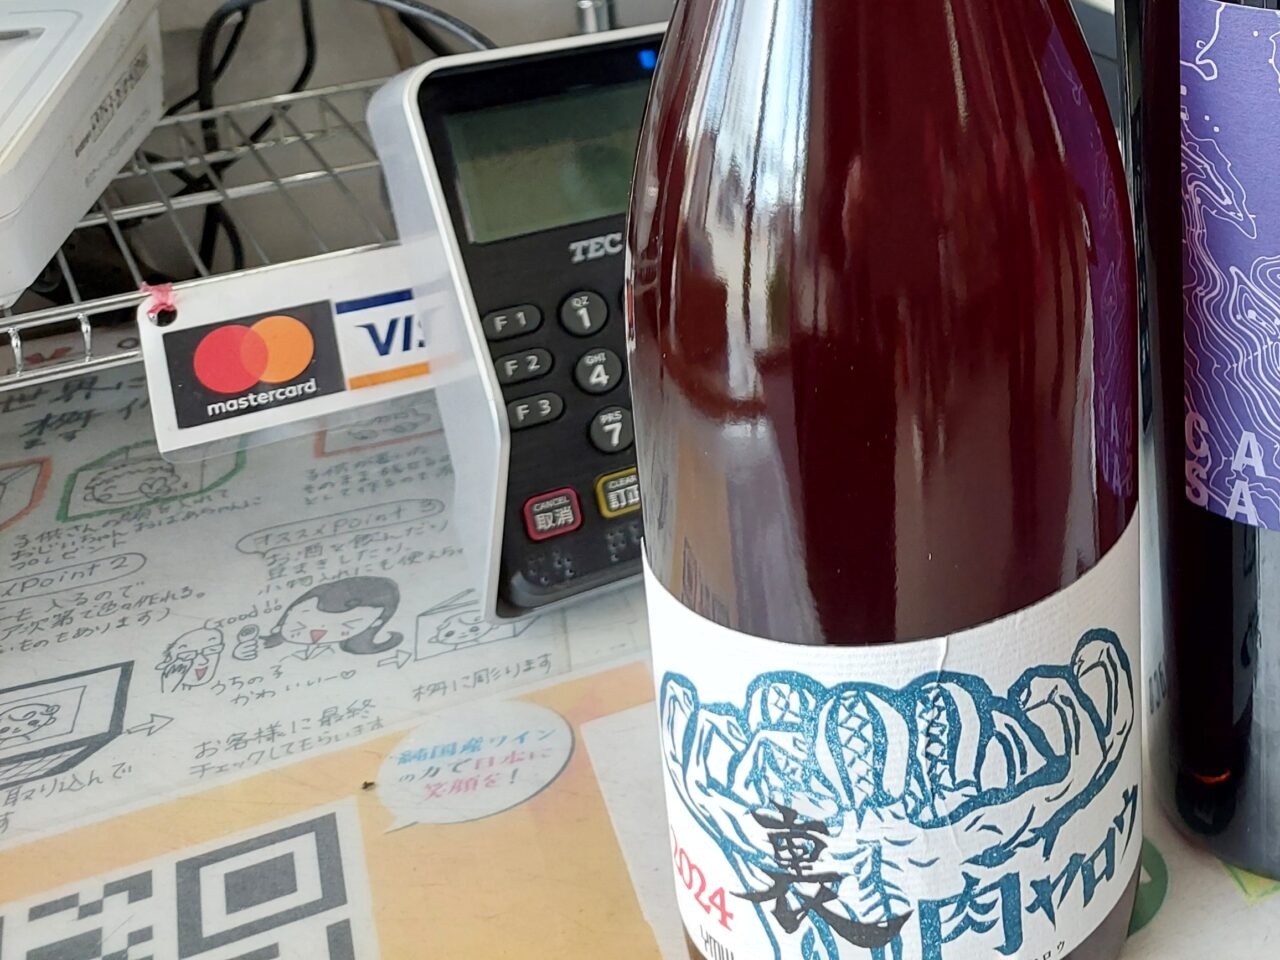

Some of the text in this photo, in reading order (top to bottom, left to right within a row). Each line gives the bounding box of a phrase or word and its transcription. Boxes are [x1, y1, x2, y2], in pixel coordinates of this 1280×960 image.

[568, 232, 624, 264] TEC
[577, 307, 592, 330] 1
[354, 314, 426, 357] VI
[589, 364, 610, 387] 4
[206, 378, 318, 417] mastercard
[603, 421, 623, 447] 7
[532, 495, 571, 513] CANCEL
[534, 505, 575, 532] 取消
[110, 556, 129, 571] 2
[729, 801, 914, 949] 裏
